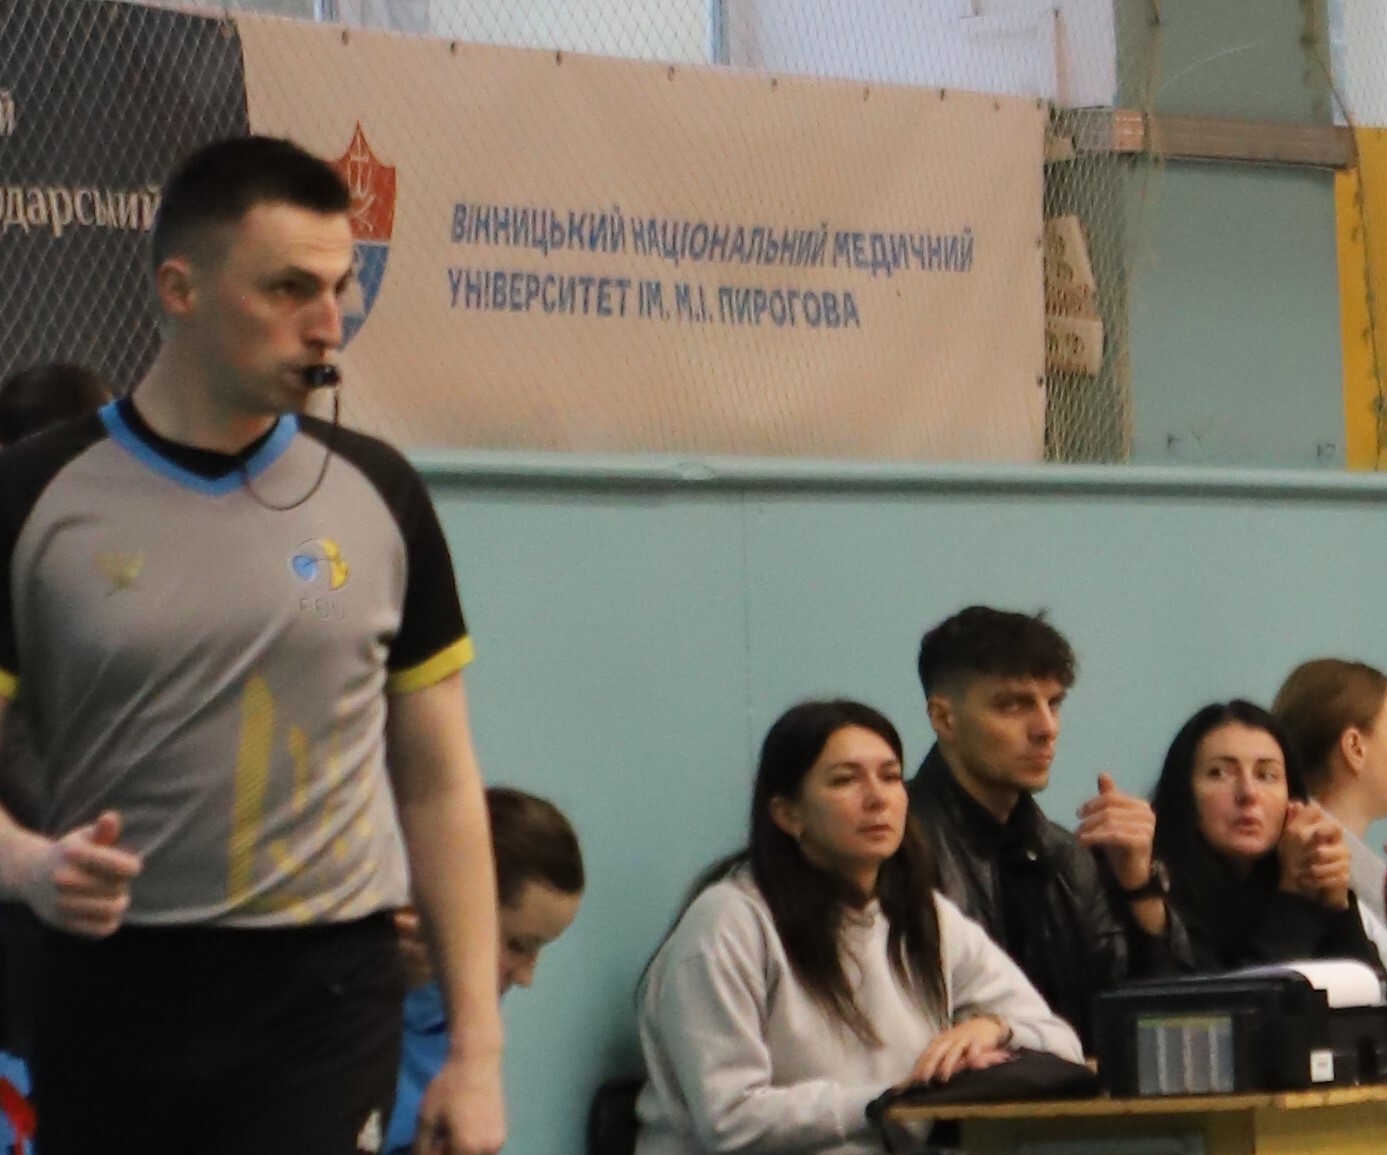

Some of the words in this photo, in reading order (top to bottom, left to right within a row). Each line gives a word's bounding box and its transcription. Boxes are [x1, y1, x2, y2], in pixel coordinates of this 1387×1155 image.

[451, 202, 626, 258] ВІННИЦЬКИЙ
[630, 216, 829, 269] НАЦІОНАЛЬНИЙ
[832, 226, 975, 278] МЕДИЧНИЙ
[447, 268, 632, 318] УНІВЕРСИТЕТ
[638, 276, 671, 321] ІМ.
[717, 286, 862, 330] ПИРОГОВА
